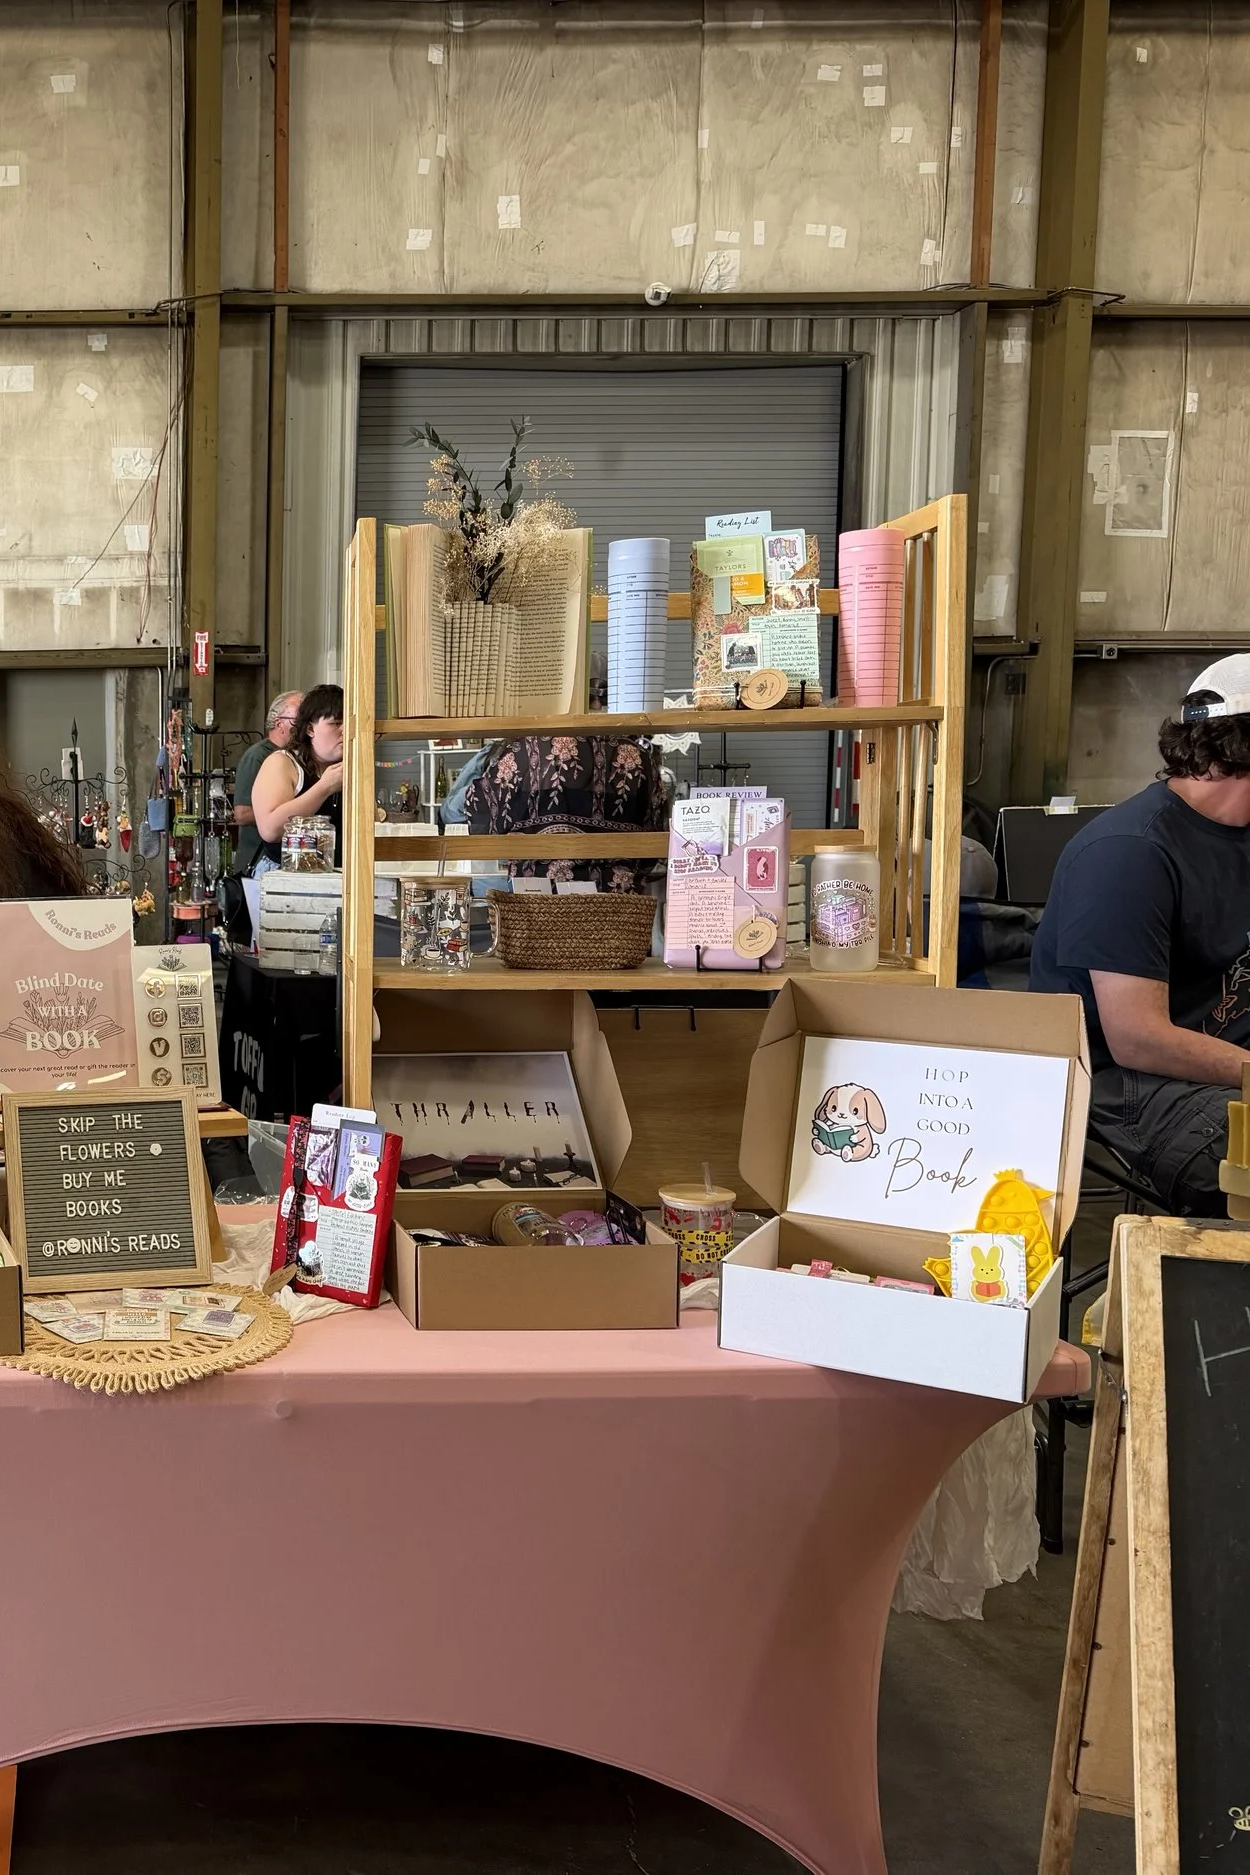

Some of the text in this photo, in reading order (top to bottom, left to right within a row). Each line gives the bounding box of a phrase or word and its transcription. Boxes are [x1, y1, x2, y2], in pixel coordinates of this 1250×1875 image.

[717, 520, 741, 529] Reading
[681, 806, 710, 815] TAZO
[44, 908, 117, 940] Ronni's Reads
[15, 972, 104, 994] Blind Date
[37, 1005, 88, 1018] WITH A
[25, 1030, 102, 1052] BOOK
[926, 1068, 969, 1083] HOP
[919, 1093, 973, 1109] INTO A
[58, 1113, 143, 1133] SKIP THE
[917, 1119, 970, 1135] GOOD
[59, 1142, 136, 1161] FLOWERS
[885, 1137, 978, 1199] Book
[62, 1170, 126, 1189] BUY ME
[66, 1199, 122, 1217] BOOKS
[129, 1234, 181, 1252] READS
